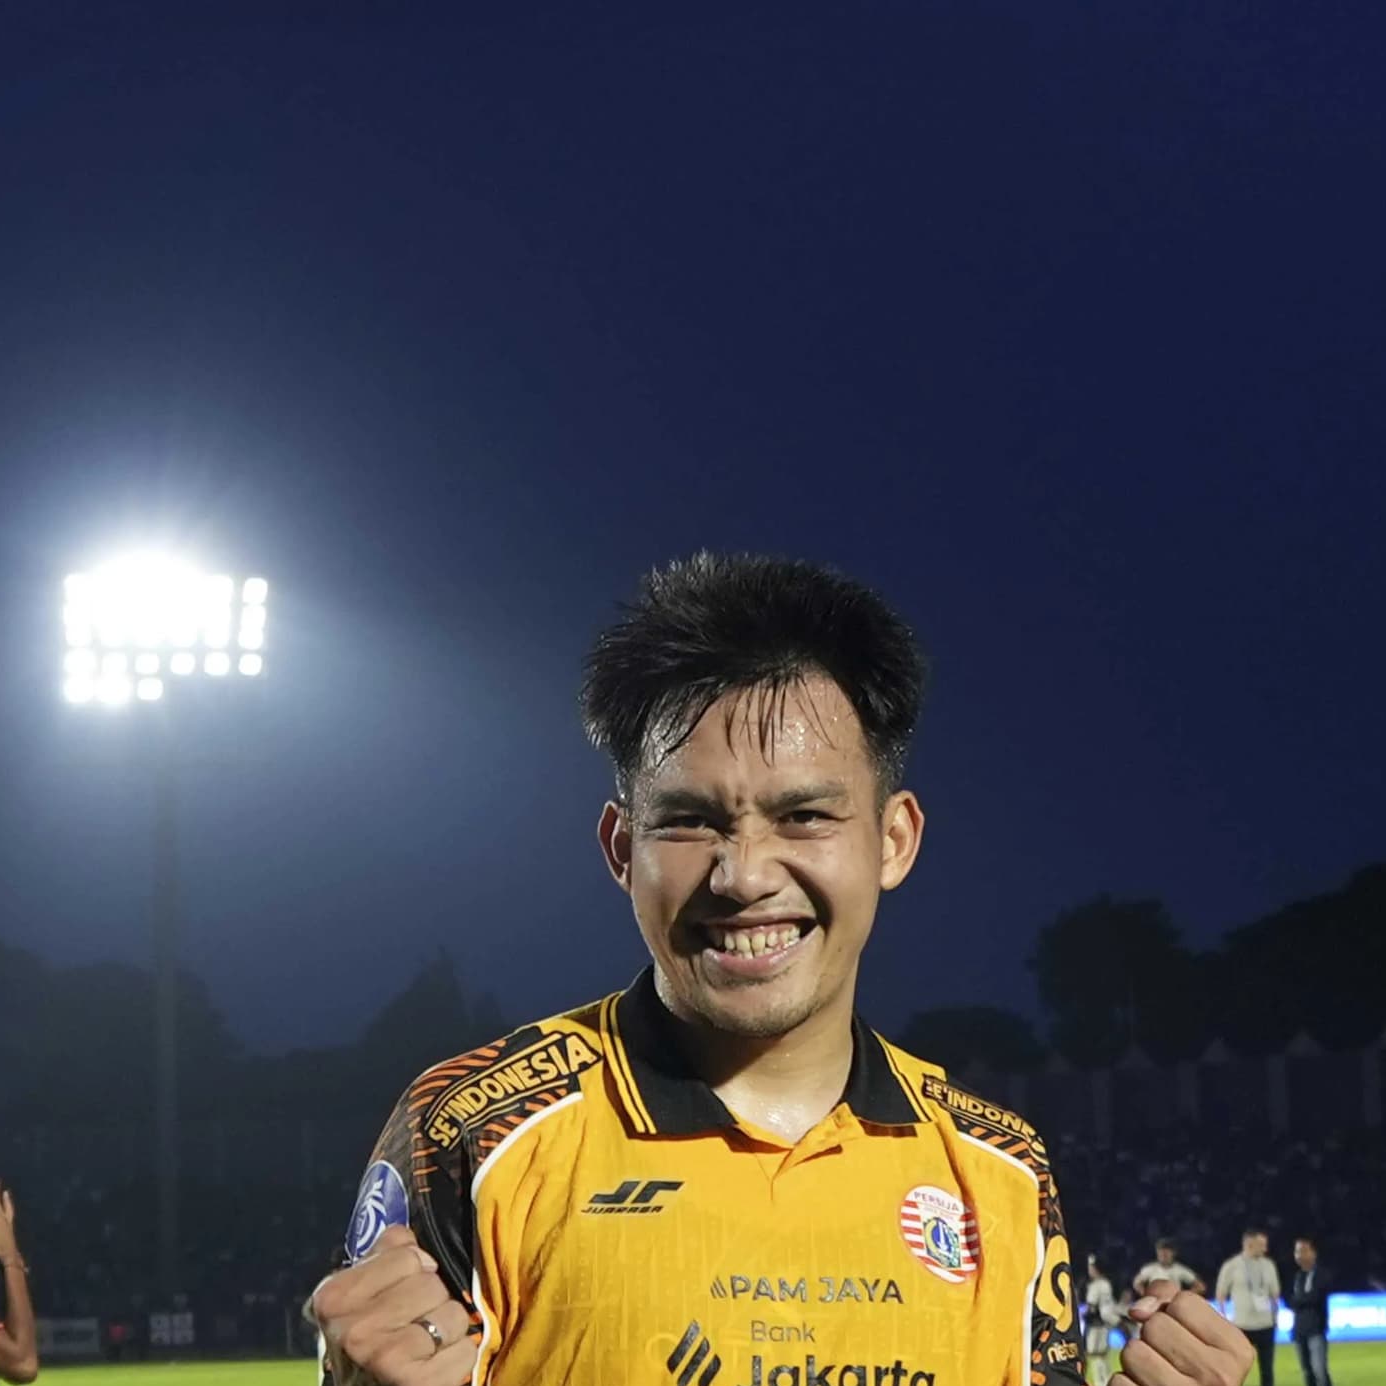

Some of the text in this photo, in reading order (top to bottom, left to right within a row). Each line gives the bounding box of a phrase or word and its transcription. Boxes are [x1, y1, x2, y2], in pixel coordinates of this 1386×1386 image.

[428, 1033, 598, 1148] SE'INDONESIA
[730, 1275, 905, 1304] PAM JAYA
[750, 1320, 816, 1343] Bank
